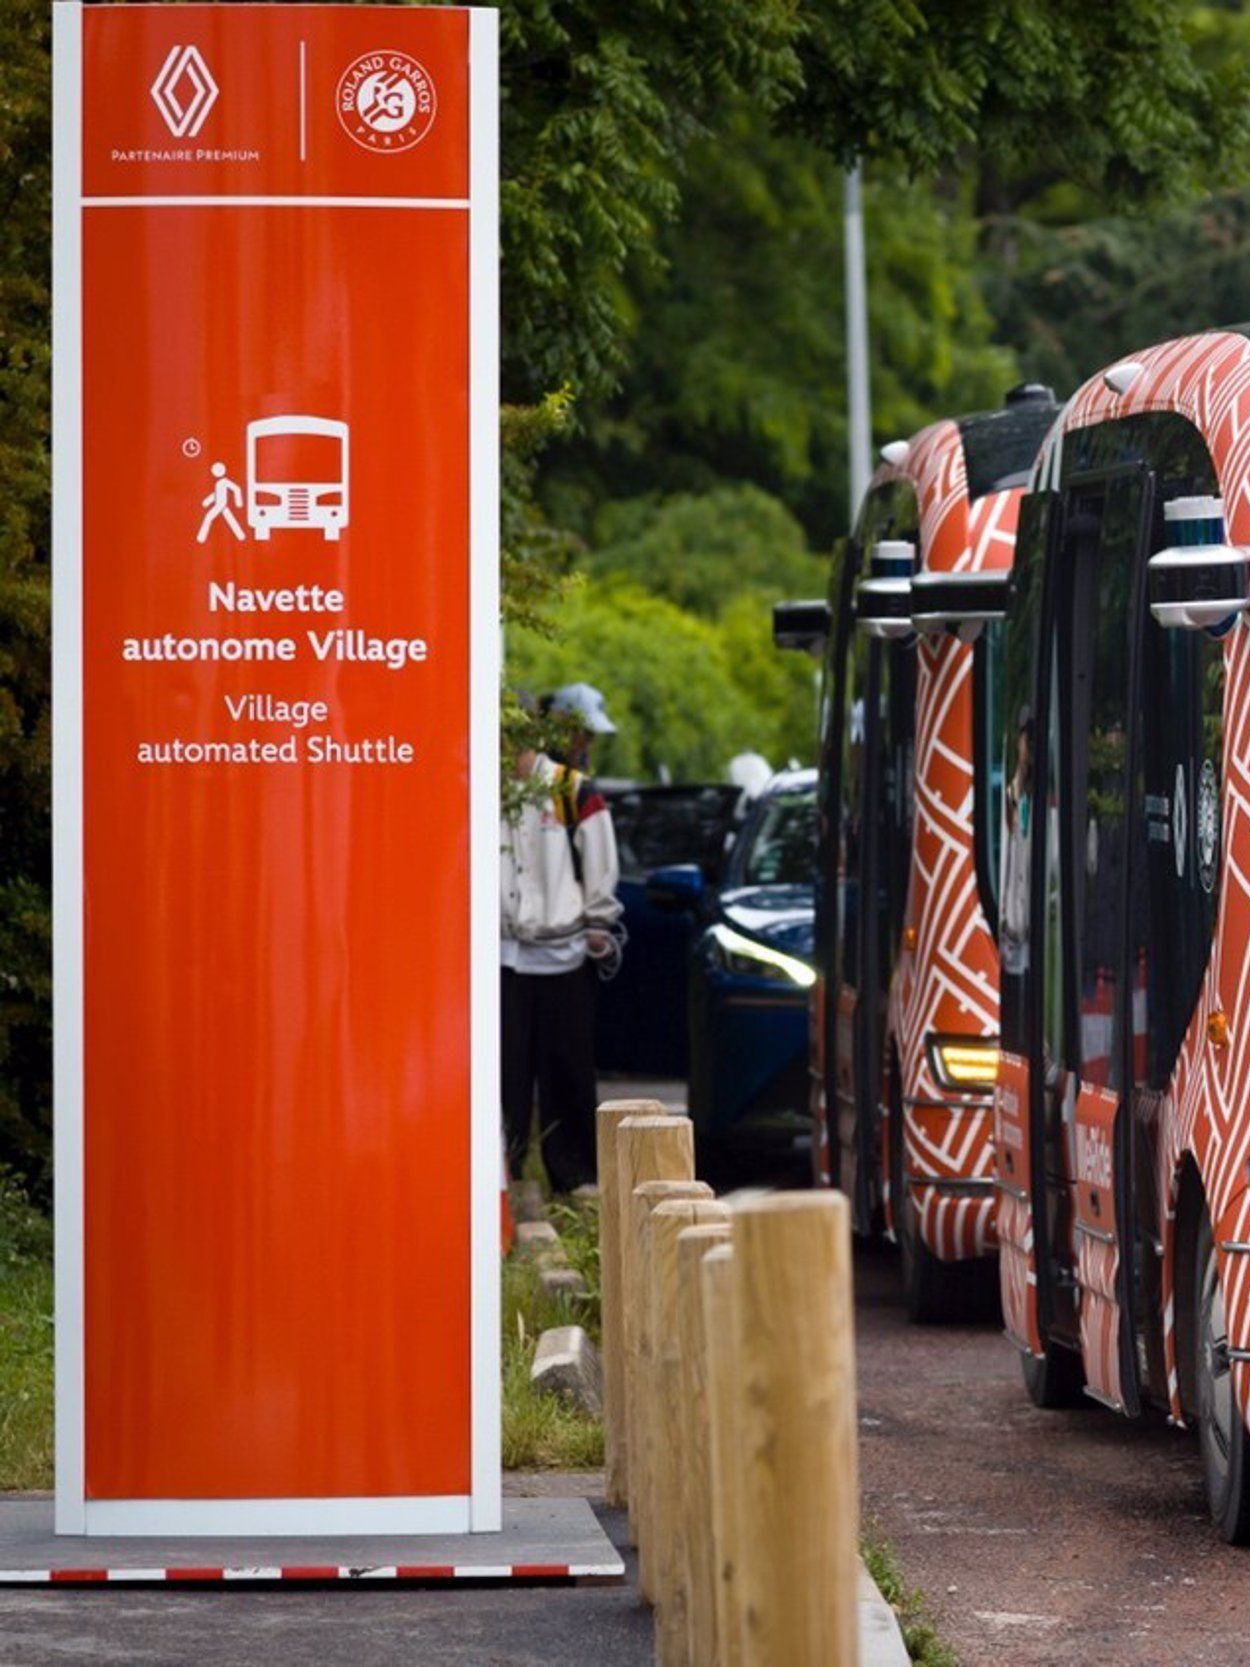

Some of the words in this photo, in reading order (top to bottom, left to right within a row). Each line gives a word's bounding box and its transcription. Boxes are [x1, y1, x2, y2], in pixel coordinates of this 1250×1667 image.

[342, 56, 384, 112] ROLAND
[389, 56, 431, 113] GARROS
[111, 150, 193, 162] PARTENAIRE
[196, 150, 259, 162] PREMIUM
[208, 582, 345, 612] Navette
[122, 633, 297, 662] autonome
[306, 630, 427, 669] Village
[224, 695, 328, 728] Village
[137, 736, 298, 764] automated
[306, 736, 414, 764] Shuttle
